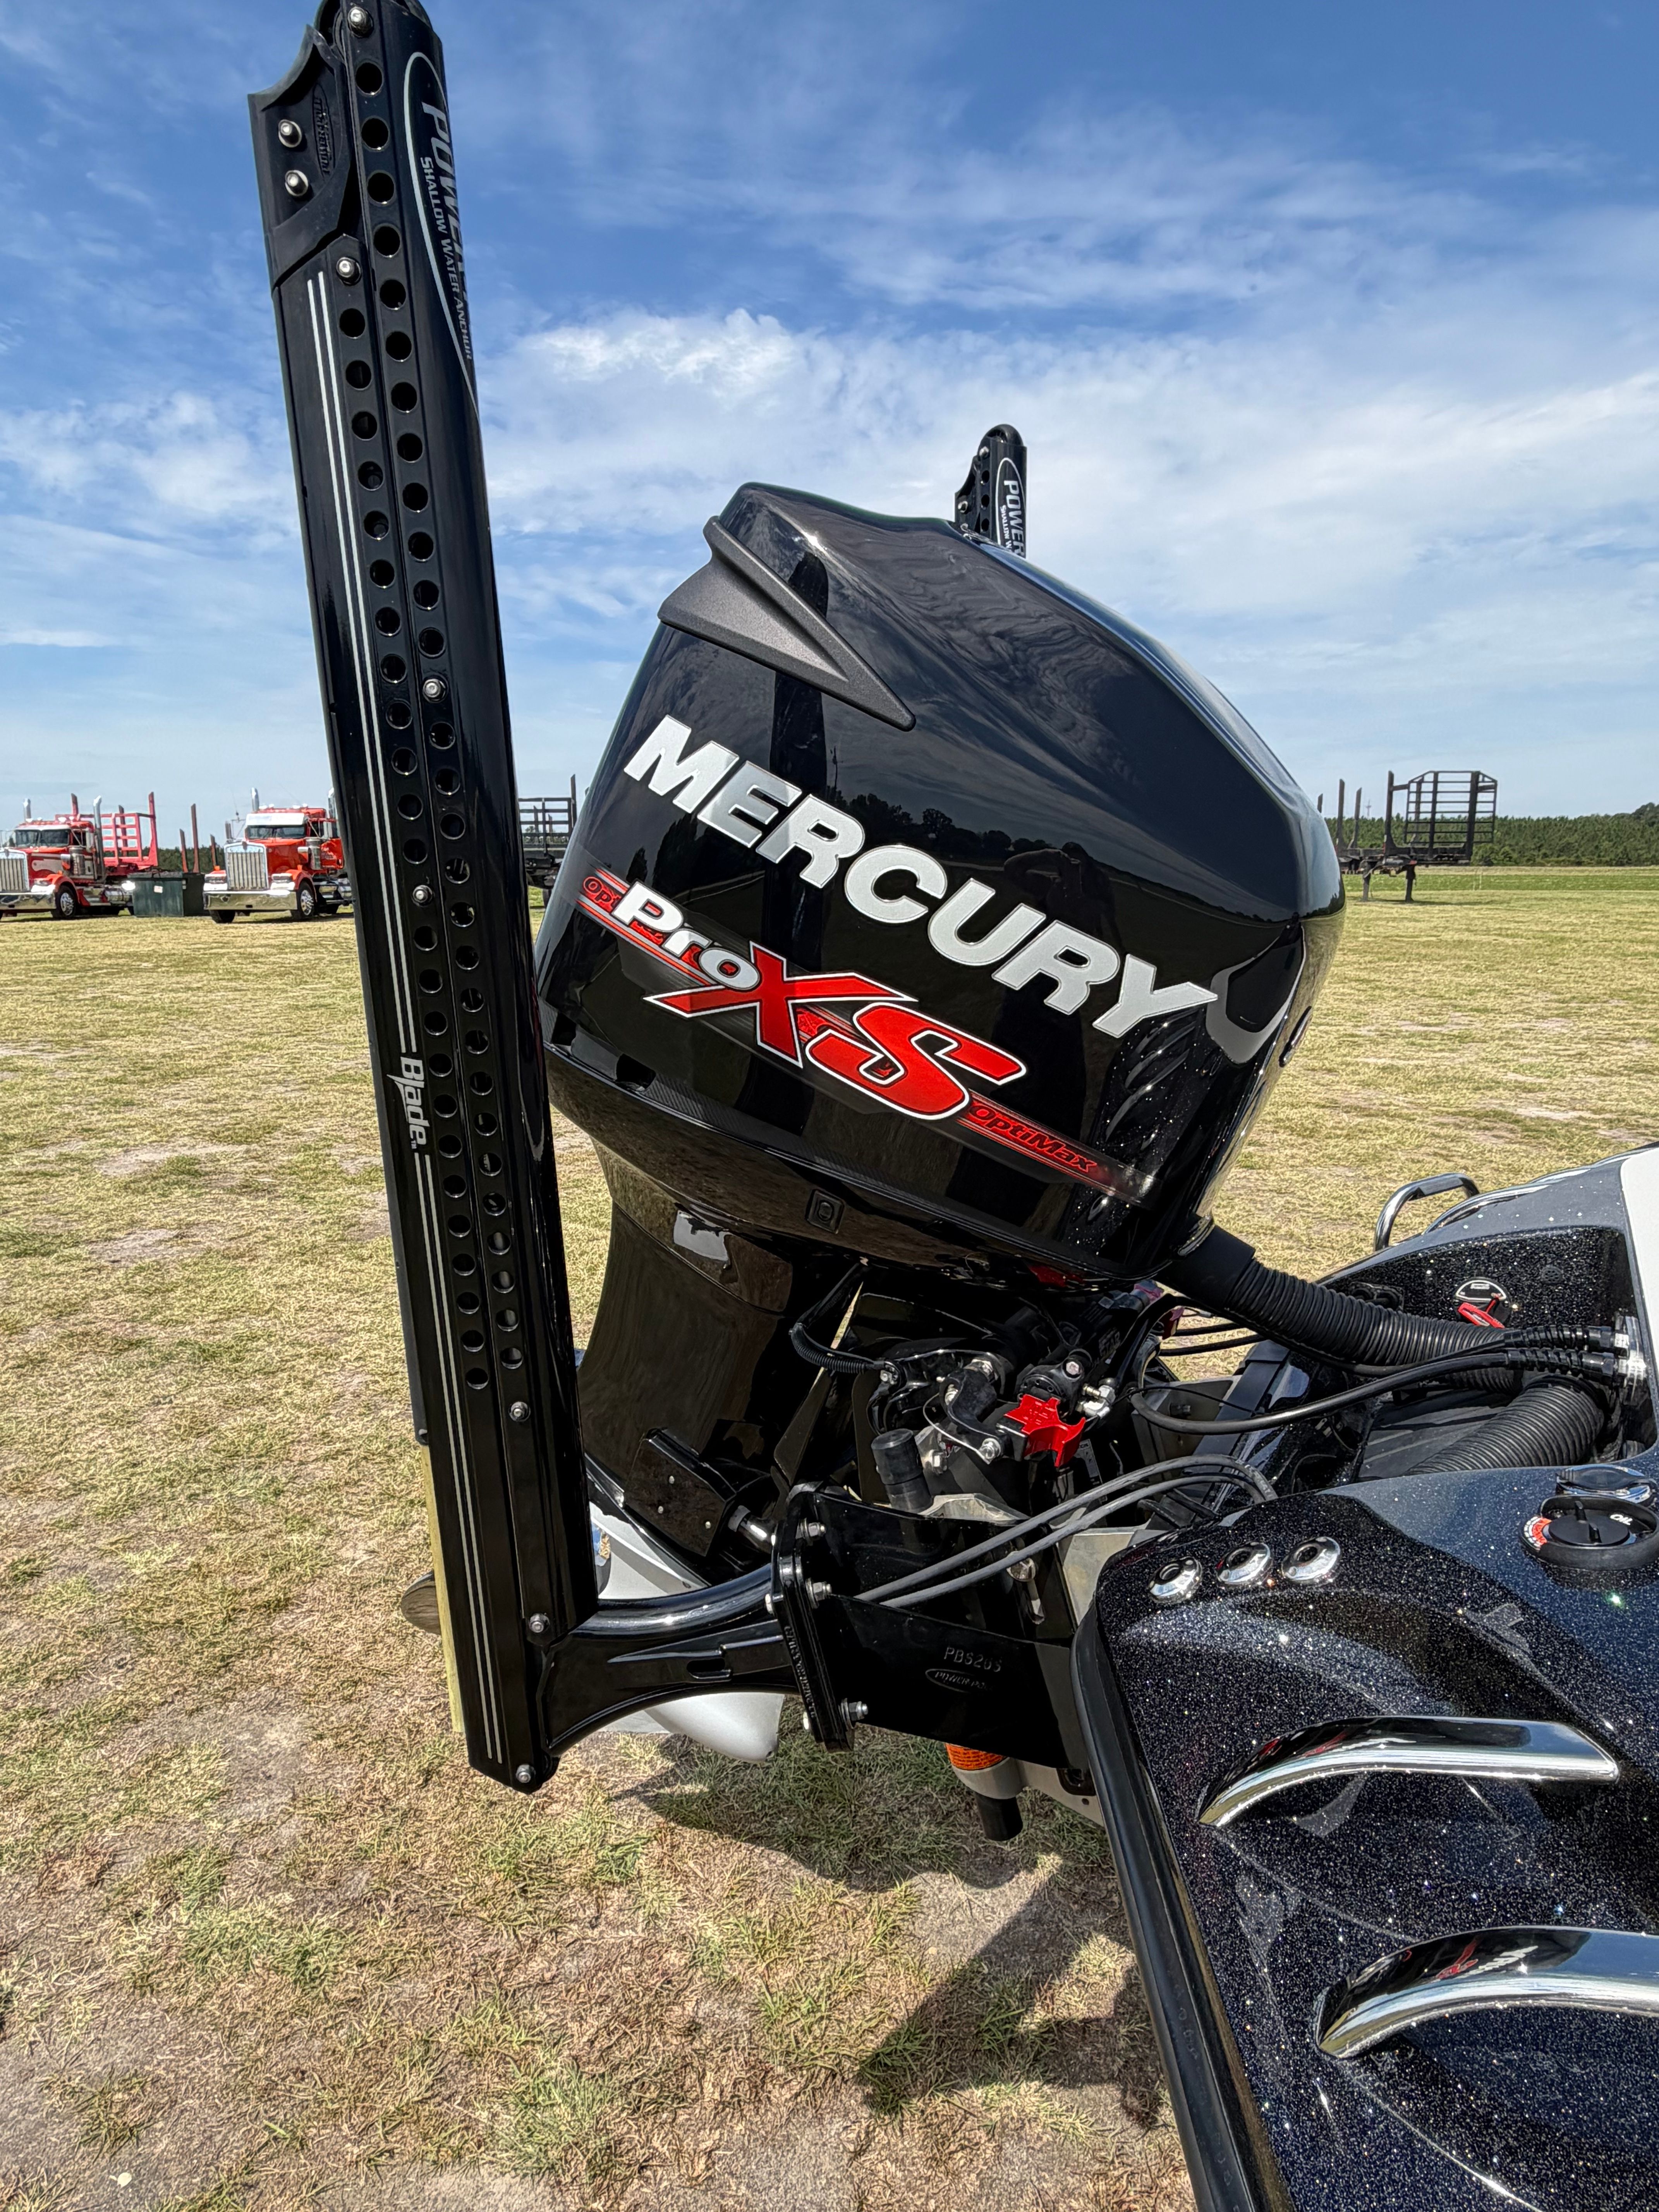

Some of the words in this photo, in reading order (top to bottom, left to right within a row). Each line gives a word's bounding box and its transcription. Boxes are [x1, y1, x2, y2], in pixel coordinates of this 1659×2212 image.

[421, 157, 448, 234] SHALLOW
[441, 238, 460, 292] WATER
[1004, 480, 1025, 556] POWER
[623, 714, 1218, 1039] MERCURY
[387, 1056, 430, 1145] Blade
[1610, 1514, 1633, 1525] OIL
